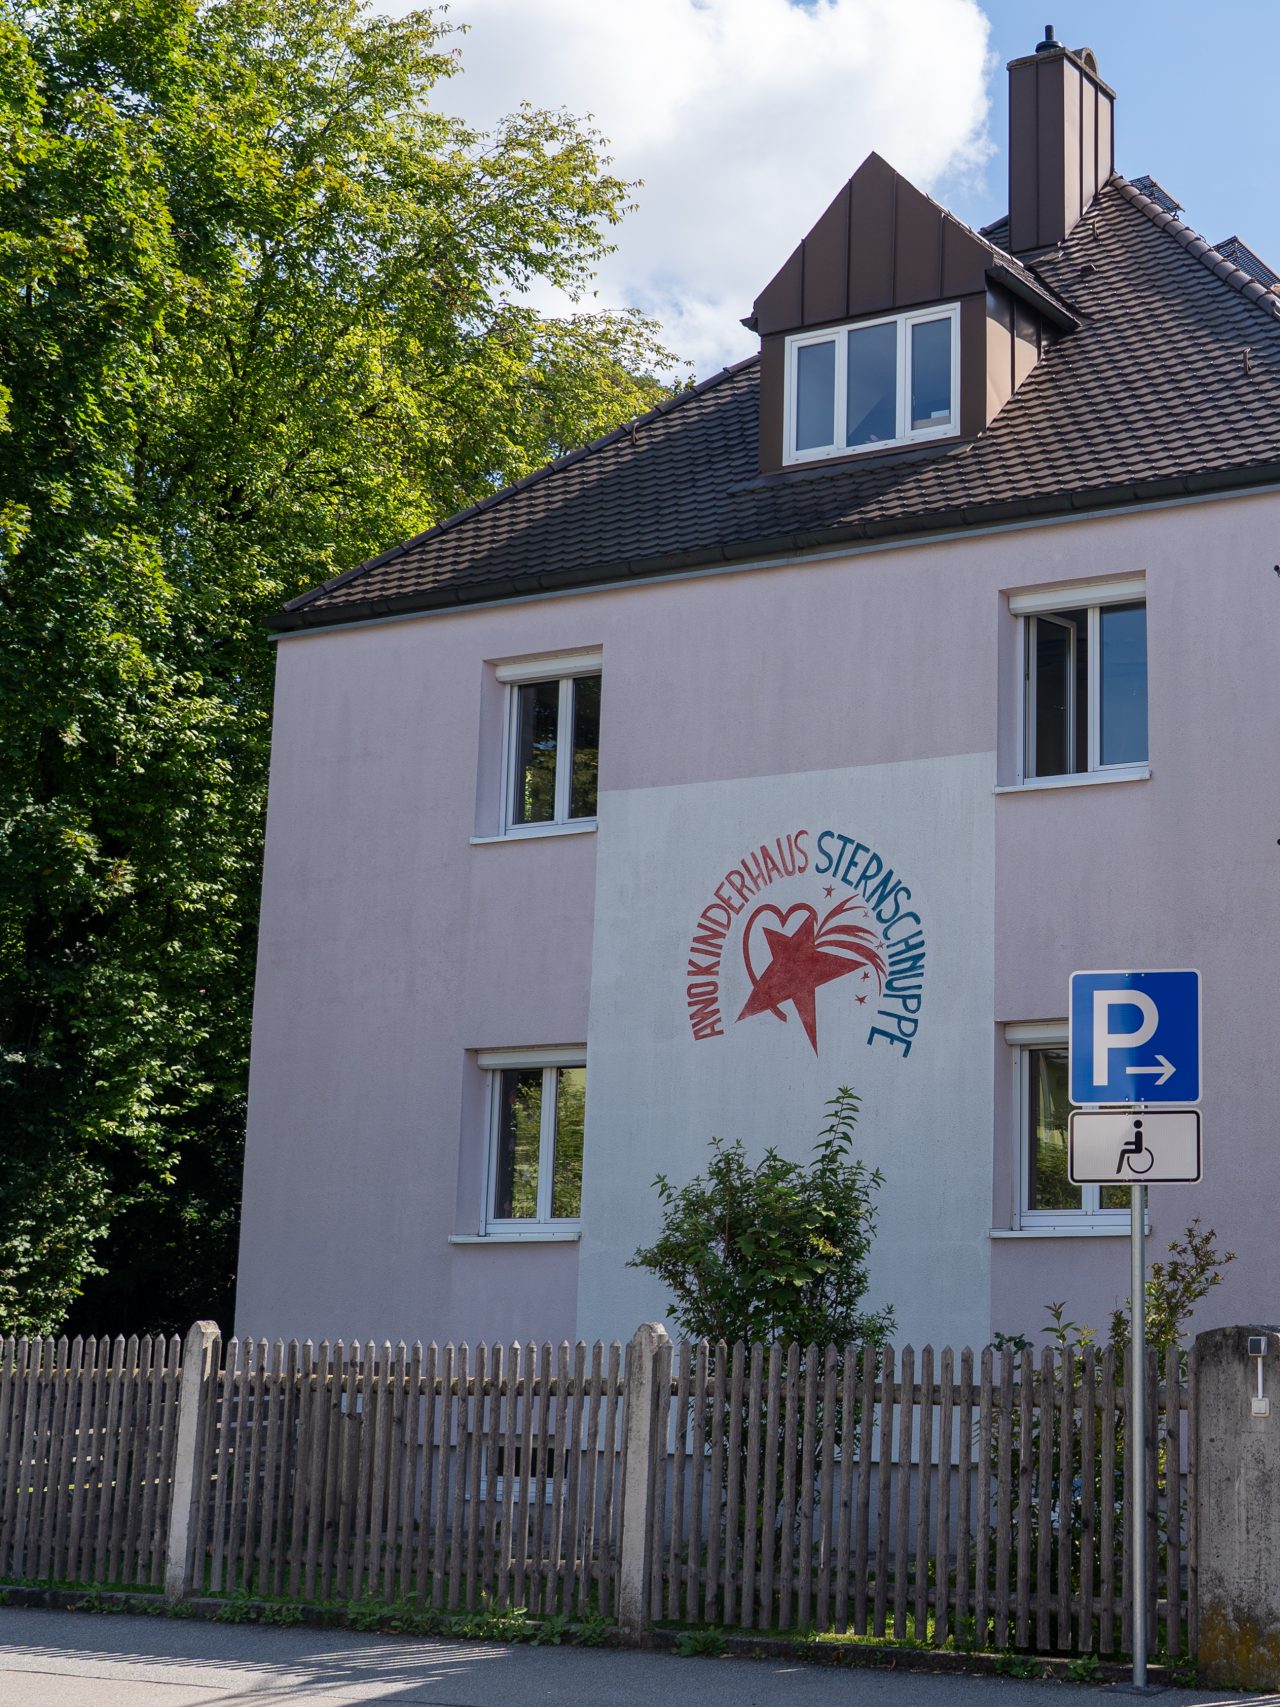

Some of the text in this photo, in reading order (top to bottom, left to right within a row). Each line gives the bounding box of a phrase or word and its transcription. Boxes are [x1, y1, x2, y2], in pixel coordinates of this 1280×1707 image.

[686, 829, 926, 1058] AWO KINDERHAUS STERNSCHNUPPE
[1093, 990, 1159, 1086] P
